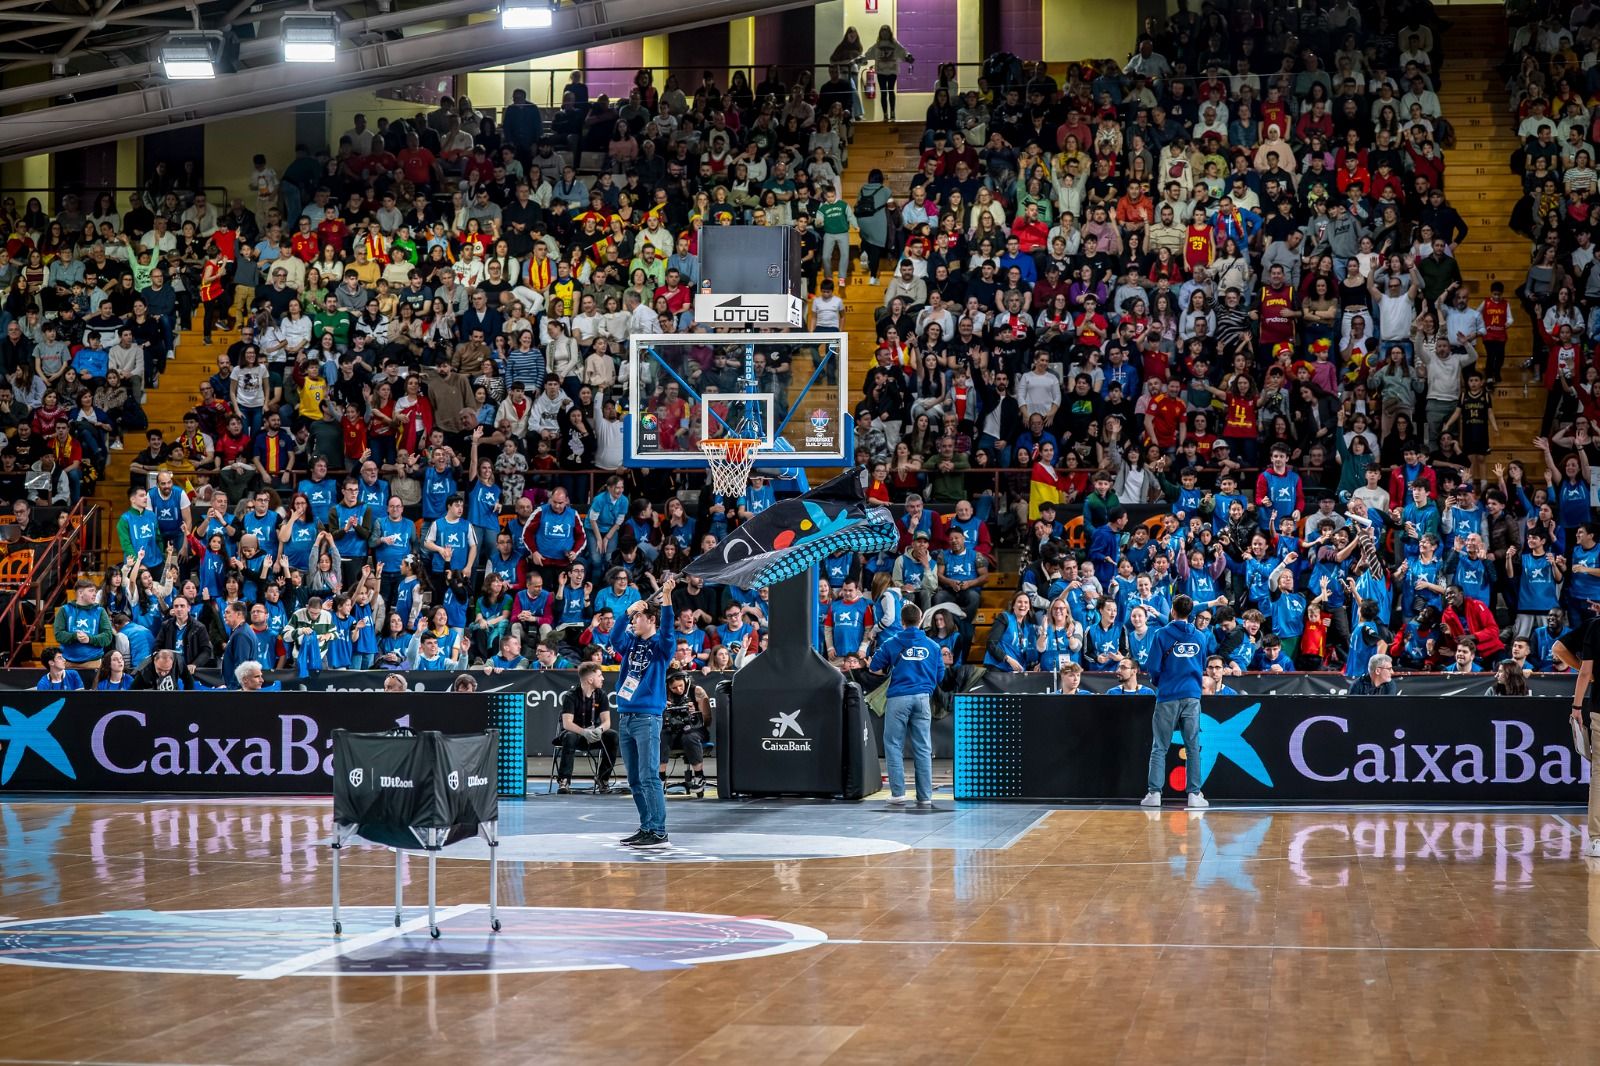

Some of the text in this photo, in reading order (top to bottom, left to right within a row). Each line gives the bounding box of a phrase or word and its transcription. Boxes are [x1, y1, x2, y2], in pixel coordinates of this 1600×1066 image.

[1193, 241, 1203, 250] 23
[713, 309, 769, 322] LOTUS
[315, 392, 321, 401] 8
[1470, 409, 1479, 418] 14
[90, 709, 410, 776] CaixaB
[762, 740, 812, 751] CaixaBank
[1288, 715, 1591, 785] CaixaBa
[380, 776, 413, 788] Wilson
